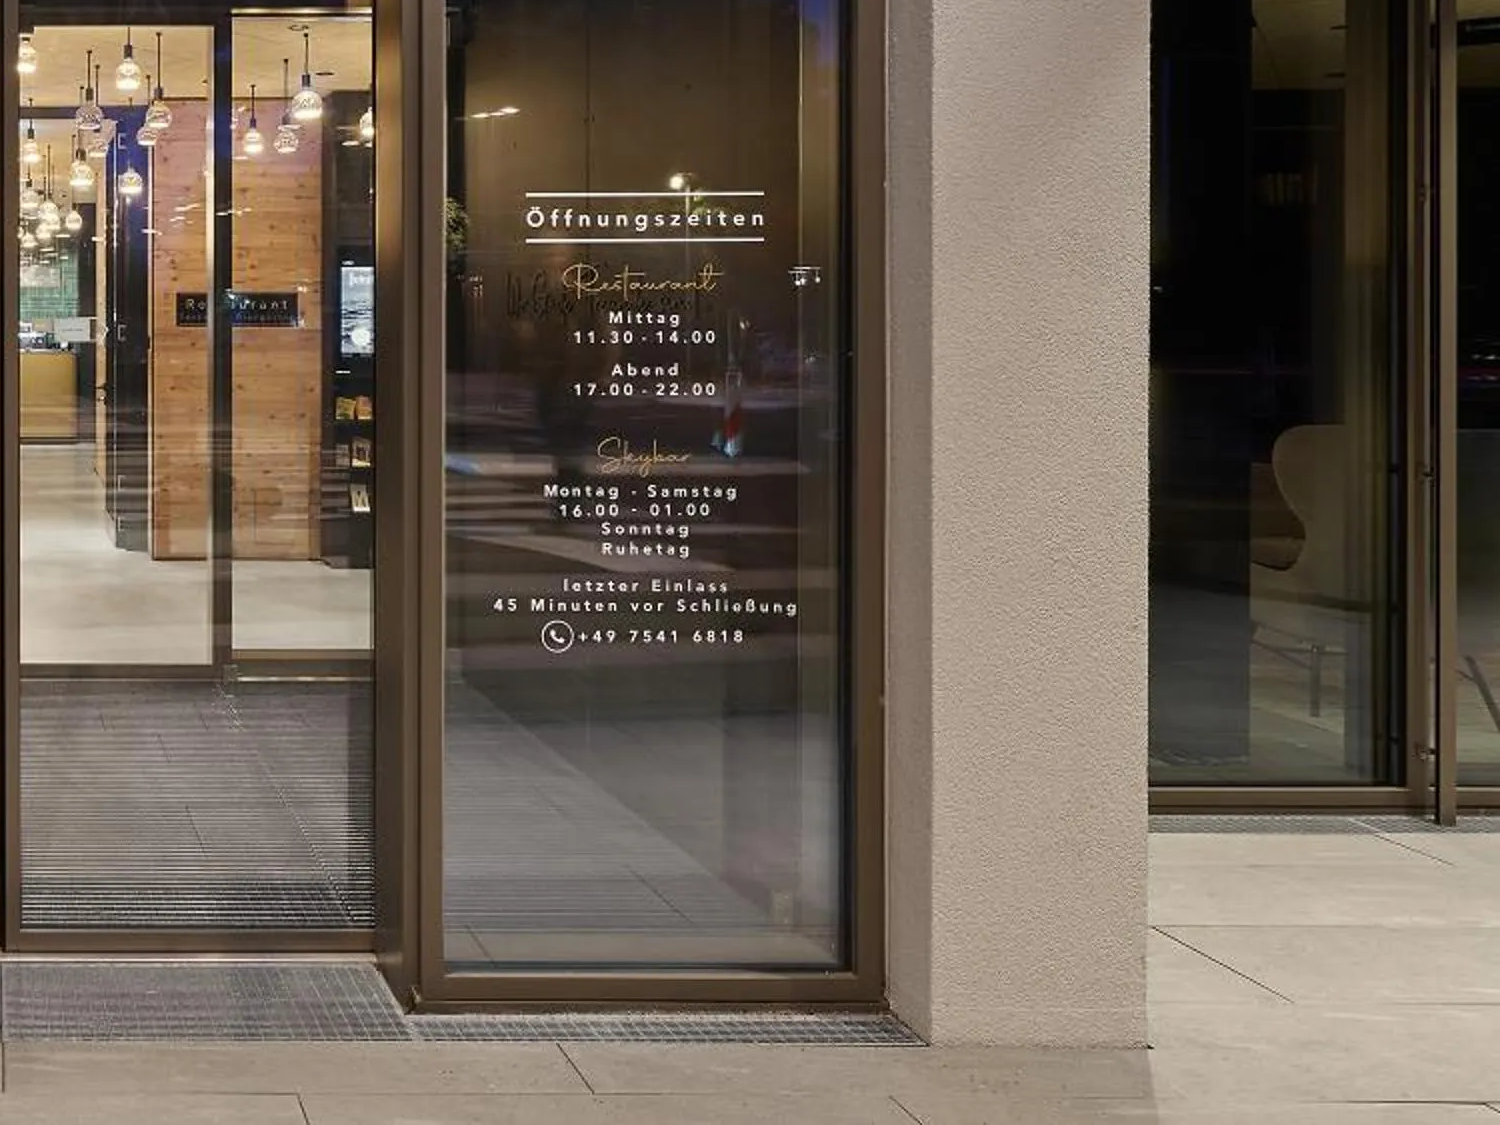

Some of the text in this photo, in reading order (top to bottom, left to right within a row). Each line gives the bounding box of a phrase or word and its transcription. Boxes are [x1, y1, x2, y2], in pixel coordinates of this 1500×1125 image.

[526, 206, 765, 231] Öffnungszeiten
[561, 262, 724, 301] Restaurant
[609, 311, 680, 328] Mittag
[573, 330, 633, 344] 11.30
[656, 330, 716, 344] 14.00
[611, 362, 679, 377] Abend
[573, 382, 633, 396] 17.00
[656, 382, 716, 396] 22.00
[544, 484, 620, 500] Montag
[647, 484, 738, 501] Samstag
[559, 503, 620, 518] 16.00
[649, 503, 711, 518] 01.00
[601, 522, 690, 539] Sonntag
[601, 542, 690, 559] Ruhetag
[563, 578, 728, 593] letzter Einlass
[493, 598, 798, 617] 45 Minuten vor Schließung
[578, 629, 744, 644] +49 7541 6818
